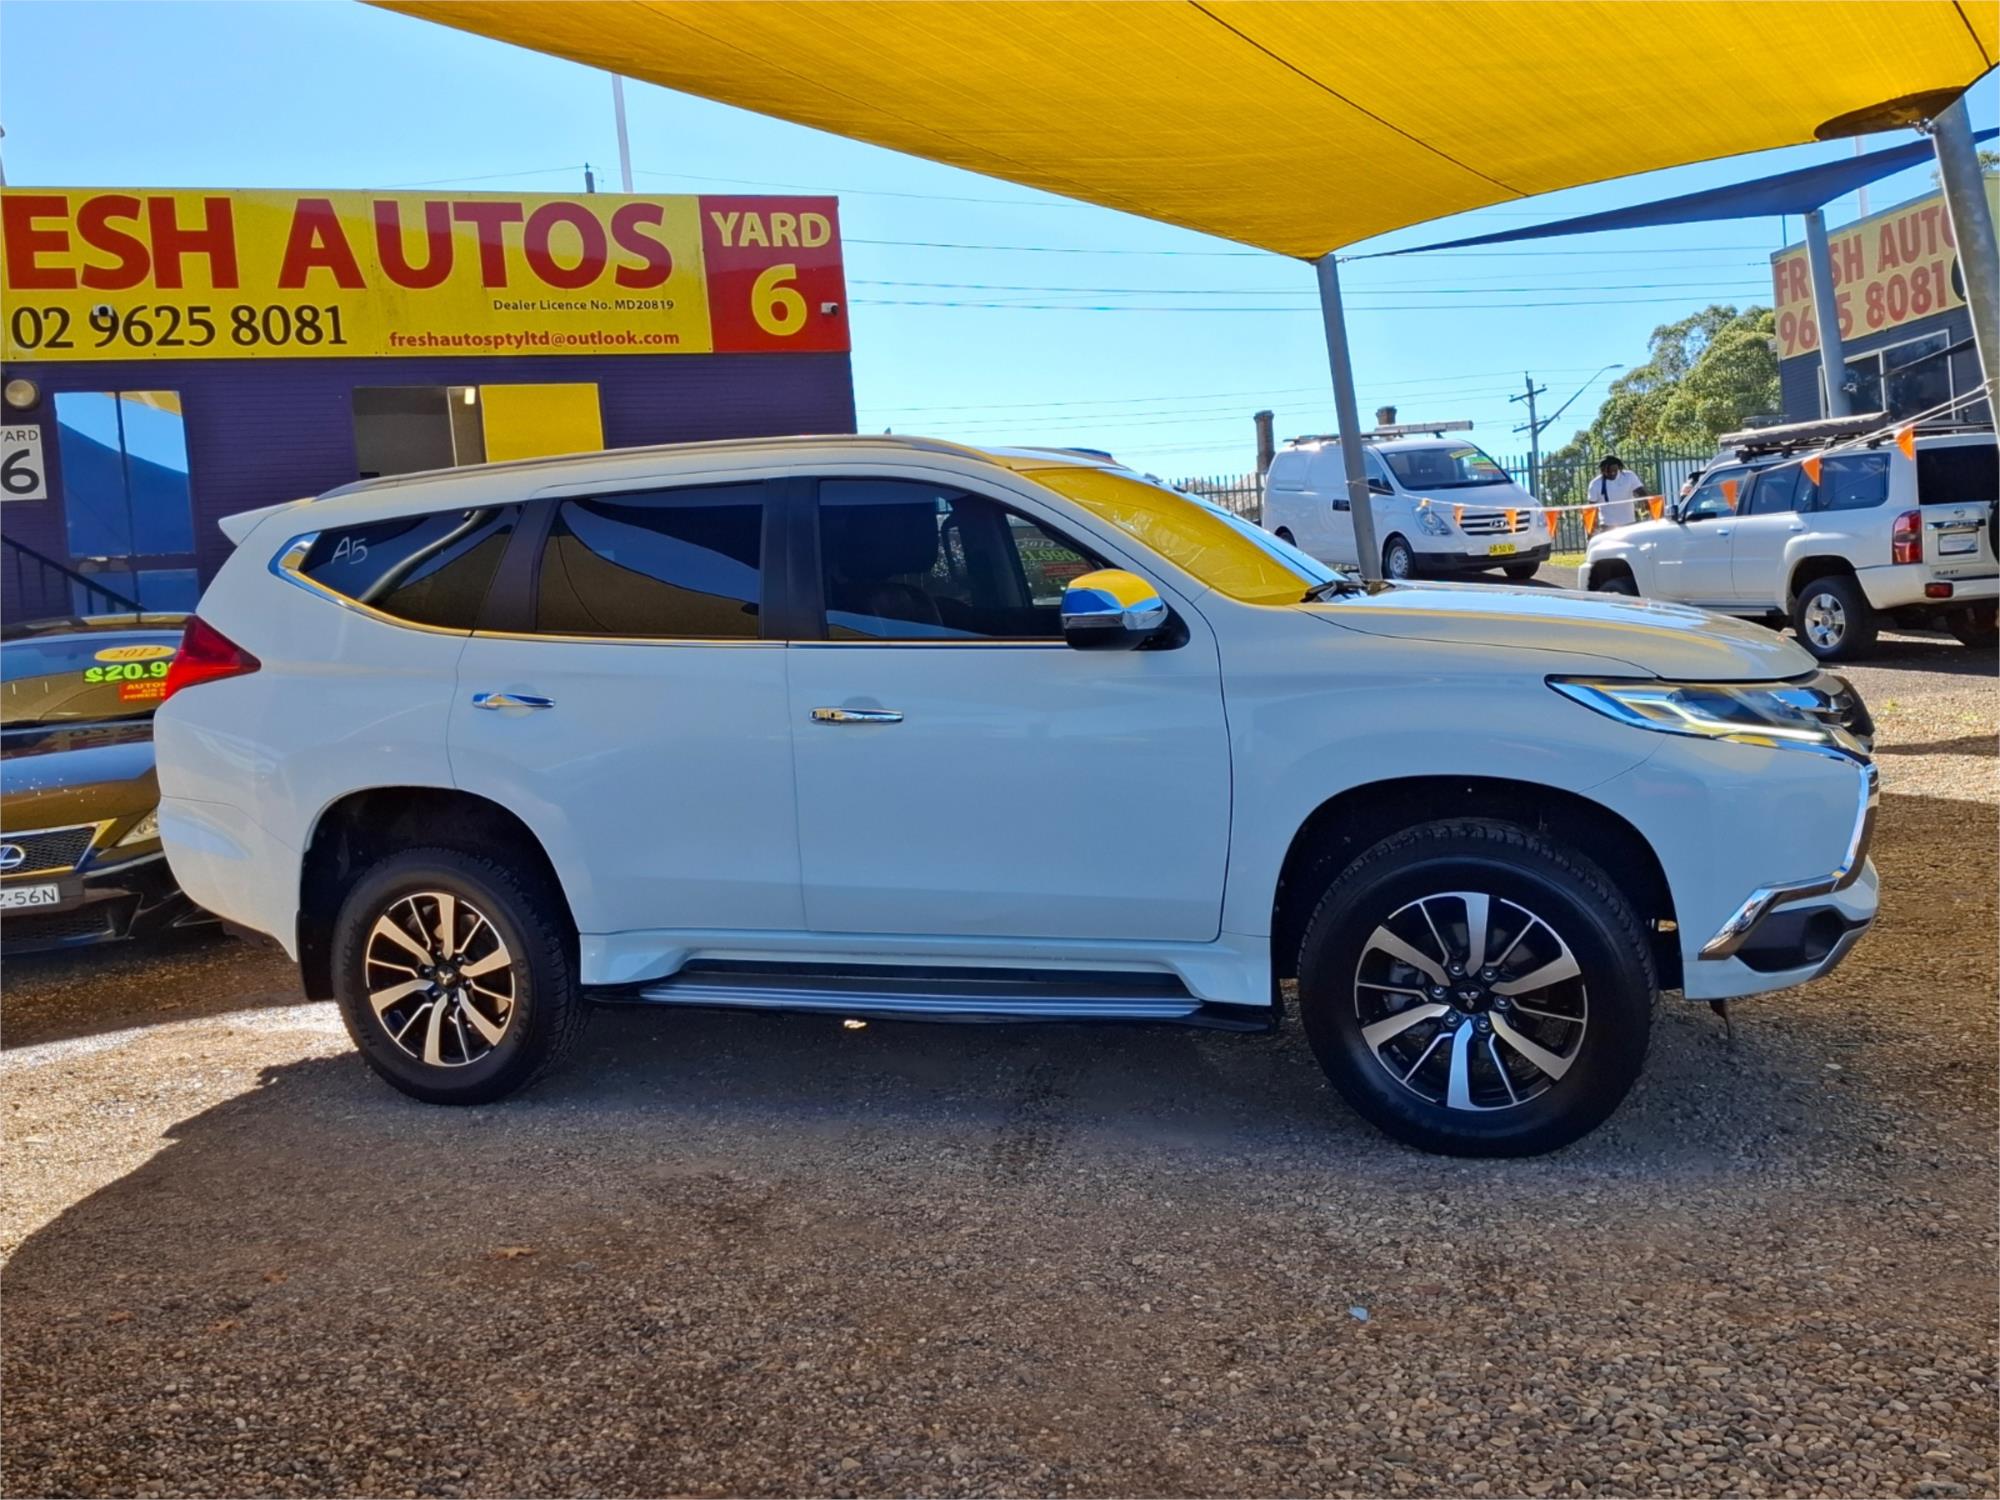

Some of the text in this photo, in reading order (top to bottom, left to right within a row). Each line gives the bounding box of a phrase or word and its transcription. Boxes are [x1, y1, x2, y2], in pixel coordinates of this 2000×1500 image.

[2, 194, 673, 290] ESH AUTOS
[709, 212, 832, 247] YARD
[1775, 234, 1864, 306] FRSH
[494, 300, 674, 310] Dealer Licence No. MD20819
[752, 264, 808, 336] 6
[1780, 260, 1946, 356] 965 8081
[11, 304, 348, 349] 02 9625 8081
[390, 331, 680, 349] freshautosptyltd@outlook.com
[0, 430, 38, 442] ARD
[1, 449, 39, 494] 6
[331, 536, 368, 564] A5
[84, 662, 173, 682] $20.9
